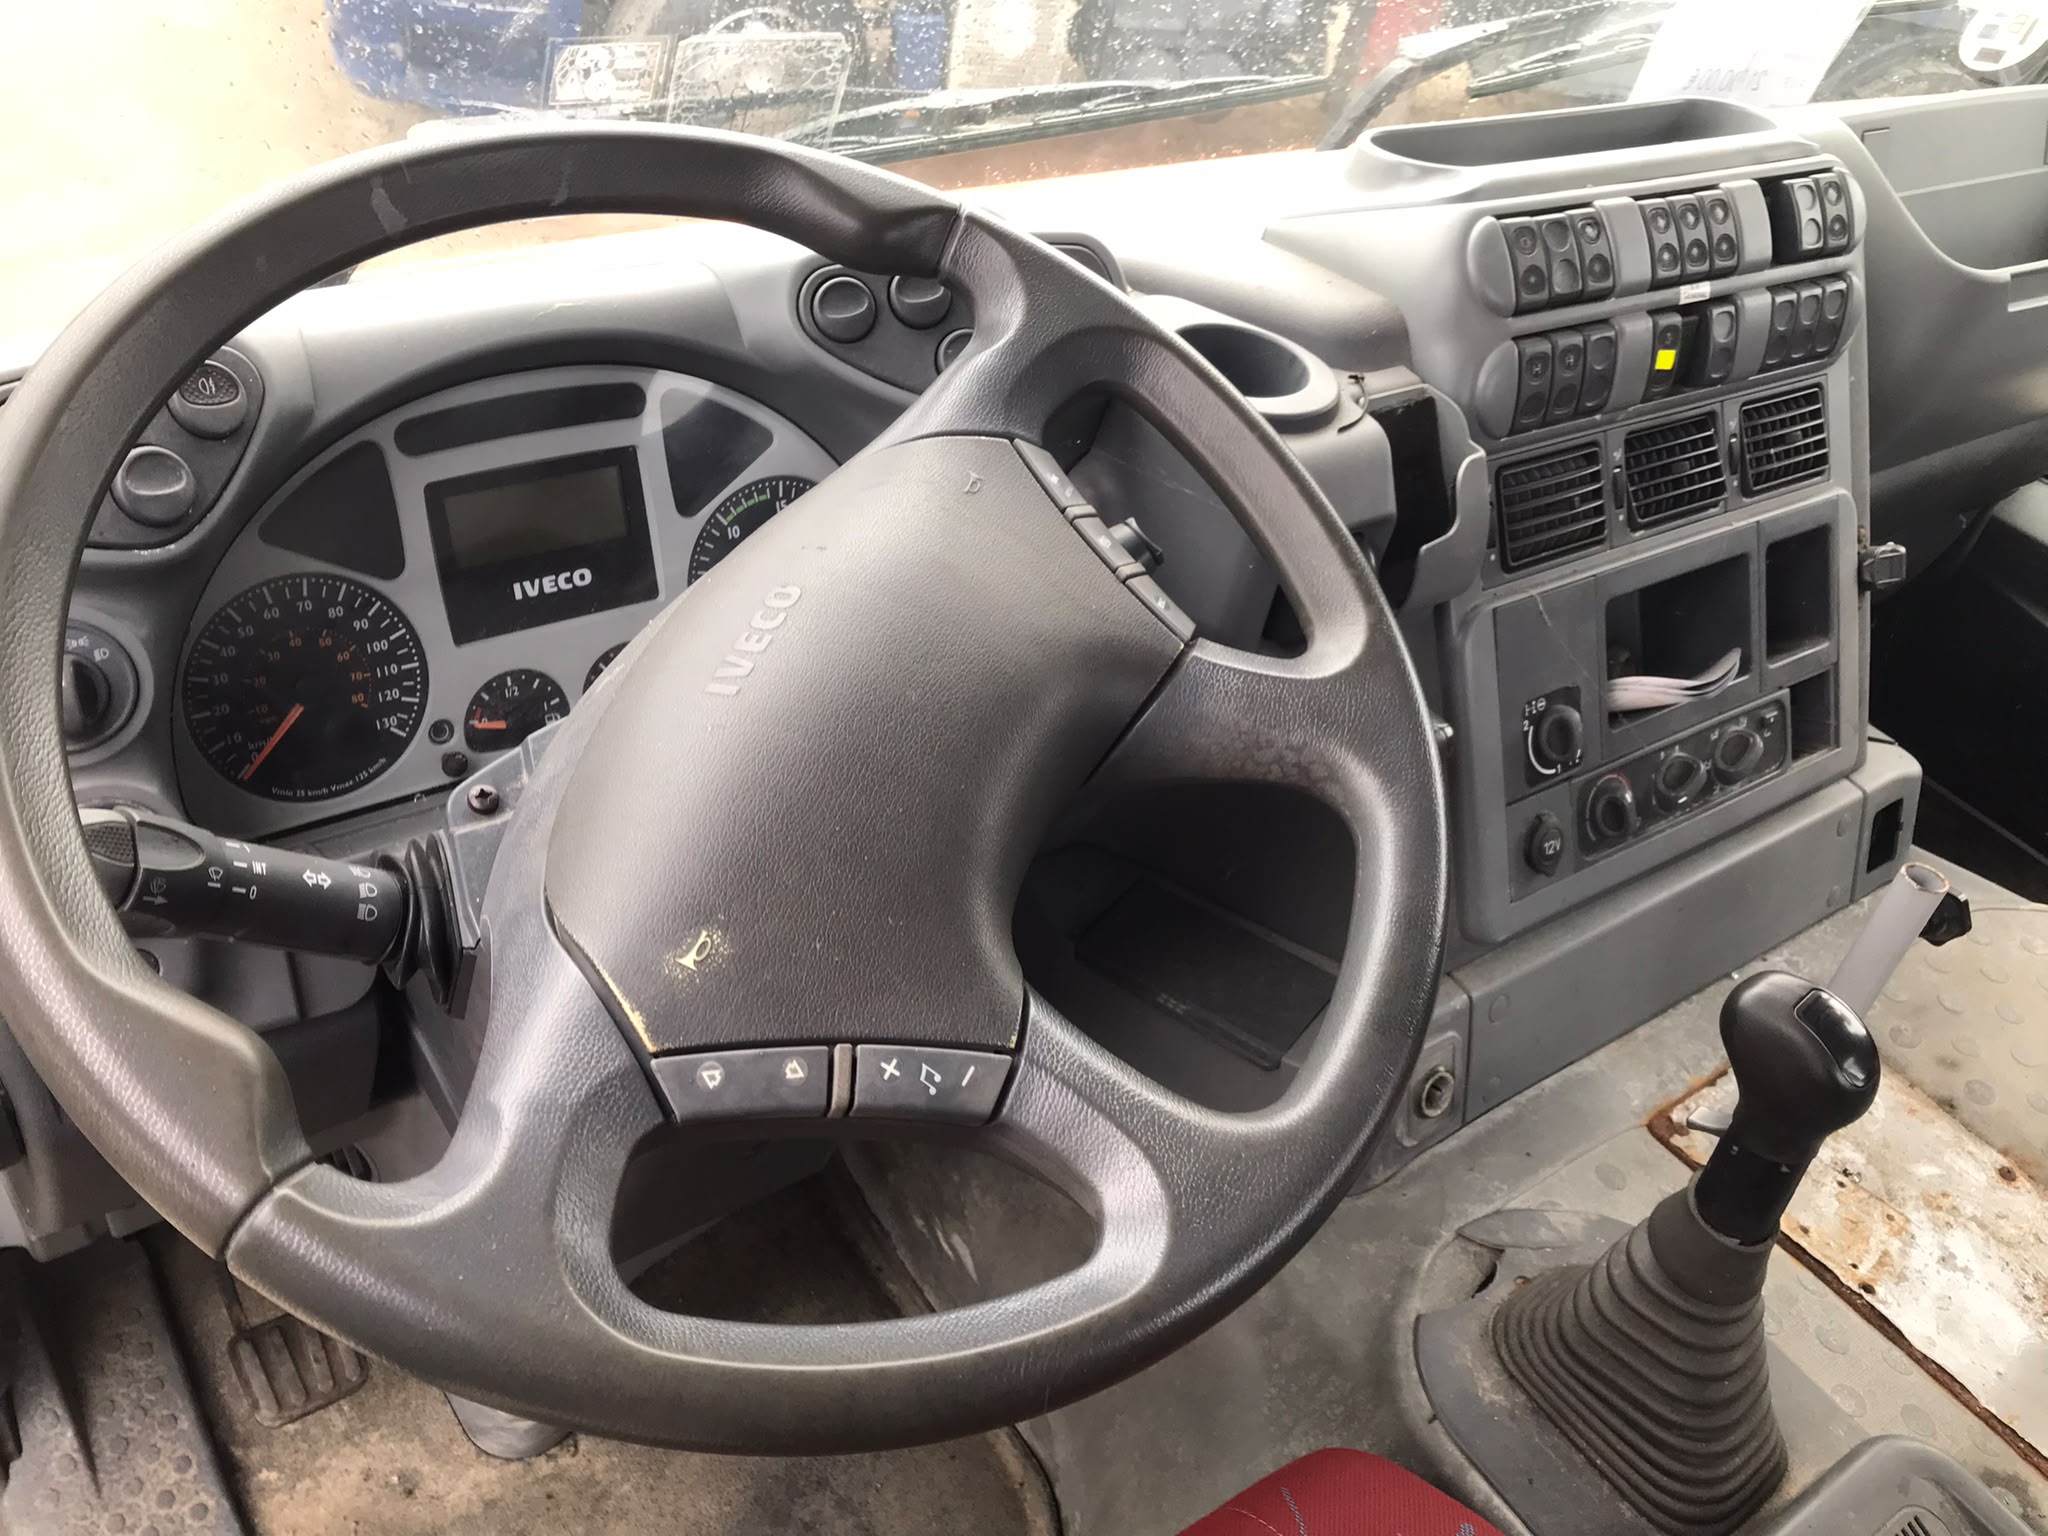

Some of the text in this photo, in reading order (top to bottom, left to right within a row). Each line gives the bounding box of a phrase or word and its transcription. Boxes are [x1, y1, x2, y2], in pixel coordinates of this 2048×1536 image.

[727, 525, 740, 540] 10
[512, 567, 593, 601] IVECO
[263, 607, 280, 620] 60
[296, 601, 313, 613] 70
[327, 606, 344, 619] 80
[353, 618, 369, 631] 90
[237, 625, 254, 639] 50
[289, 636, 302, 648] 40
[366, 639, 389, 654] 100
[703, 584, 802, 697] IVECO
[219, 646, 236, 658] 40
[337, 652, 350, 663] 60
[376, 664, 398, 678] 110
[212, 673, 229, 686] 30
[378, 688, 400, 704] 120
[504, 685, 520, 699] 1/2
[213, 703, 230, 716] 20
[375, 716, 398, 731] 130
[1523, 720, 1529, 731] 2
[226, 732, 242, 745] 10
[1544, 838, 1561, 855] 12V
[252, 861, 267, 876] INT
